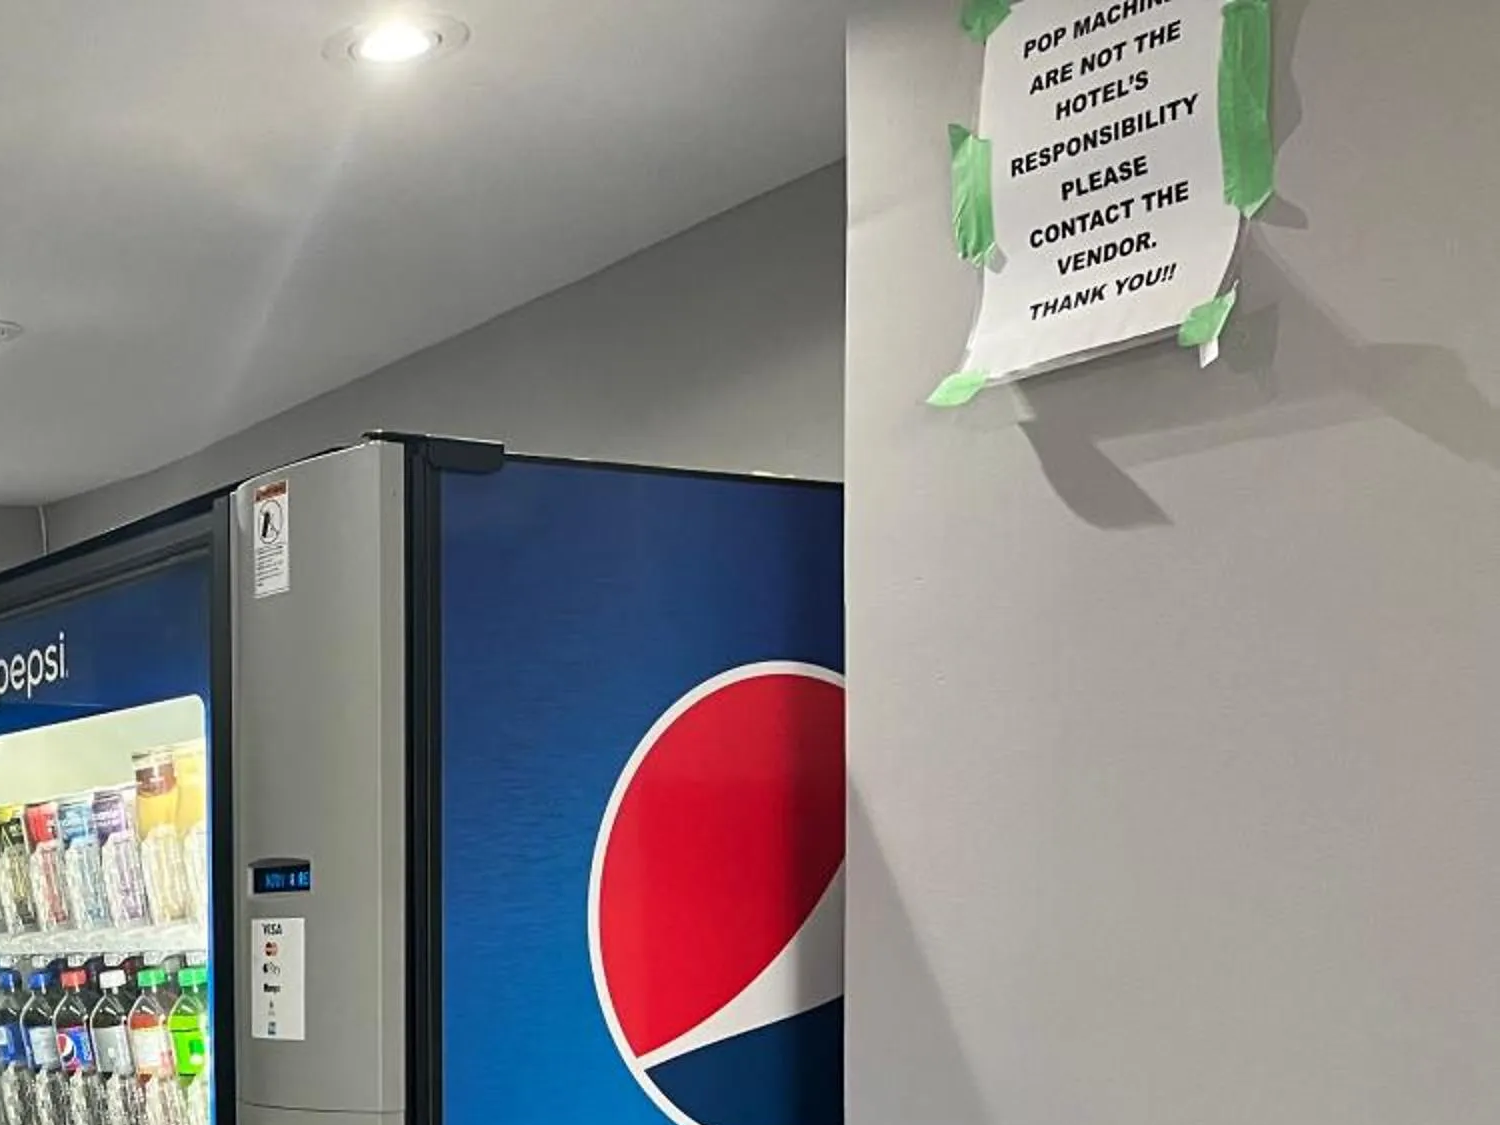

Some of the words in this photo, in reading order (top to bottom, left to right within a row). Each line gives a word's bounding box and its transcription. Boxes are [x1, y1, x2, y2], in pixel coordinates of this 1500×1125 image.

[1023, 27, 1067, 59] POP
[1073, 0, 1171, 40] MACHI
[1029, 62, 1074, 95] ARE
[1080, 41, 1128, 76] NOT
[1133, 19, 1181, 54] THE
[1056, 70, 1149, 121] HOTEL'S
[1011, 93, 1199, 178] RESPONSIBILITY
[1061, 155, 1149, 201] PLEASE
[1029, 197, 1135, 249] CONTACT
[1141, 180, 1189, 212] THE
[1057, 231, 1157, 275] VENDOR.
[1030, 283, 1107, 320] THANK
[1115, 263, 1177, 295] YOU!!
